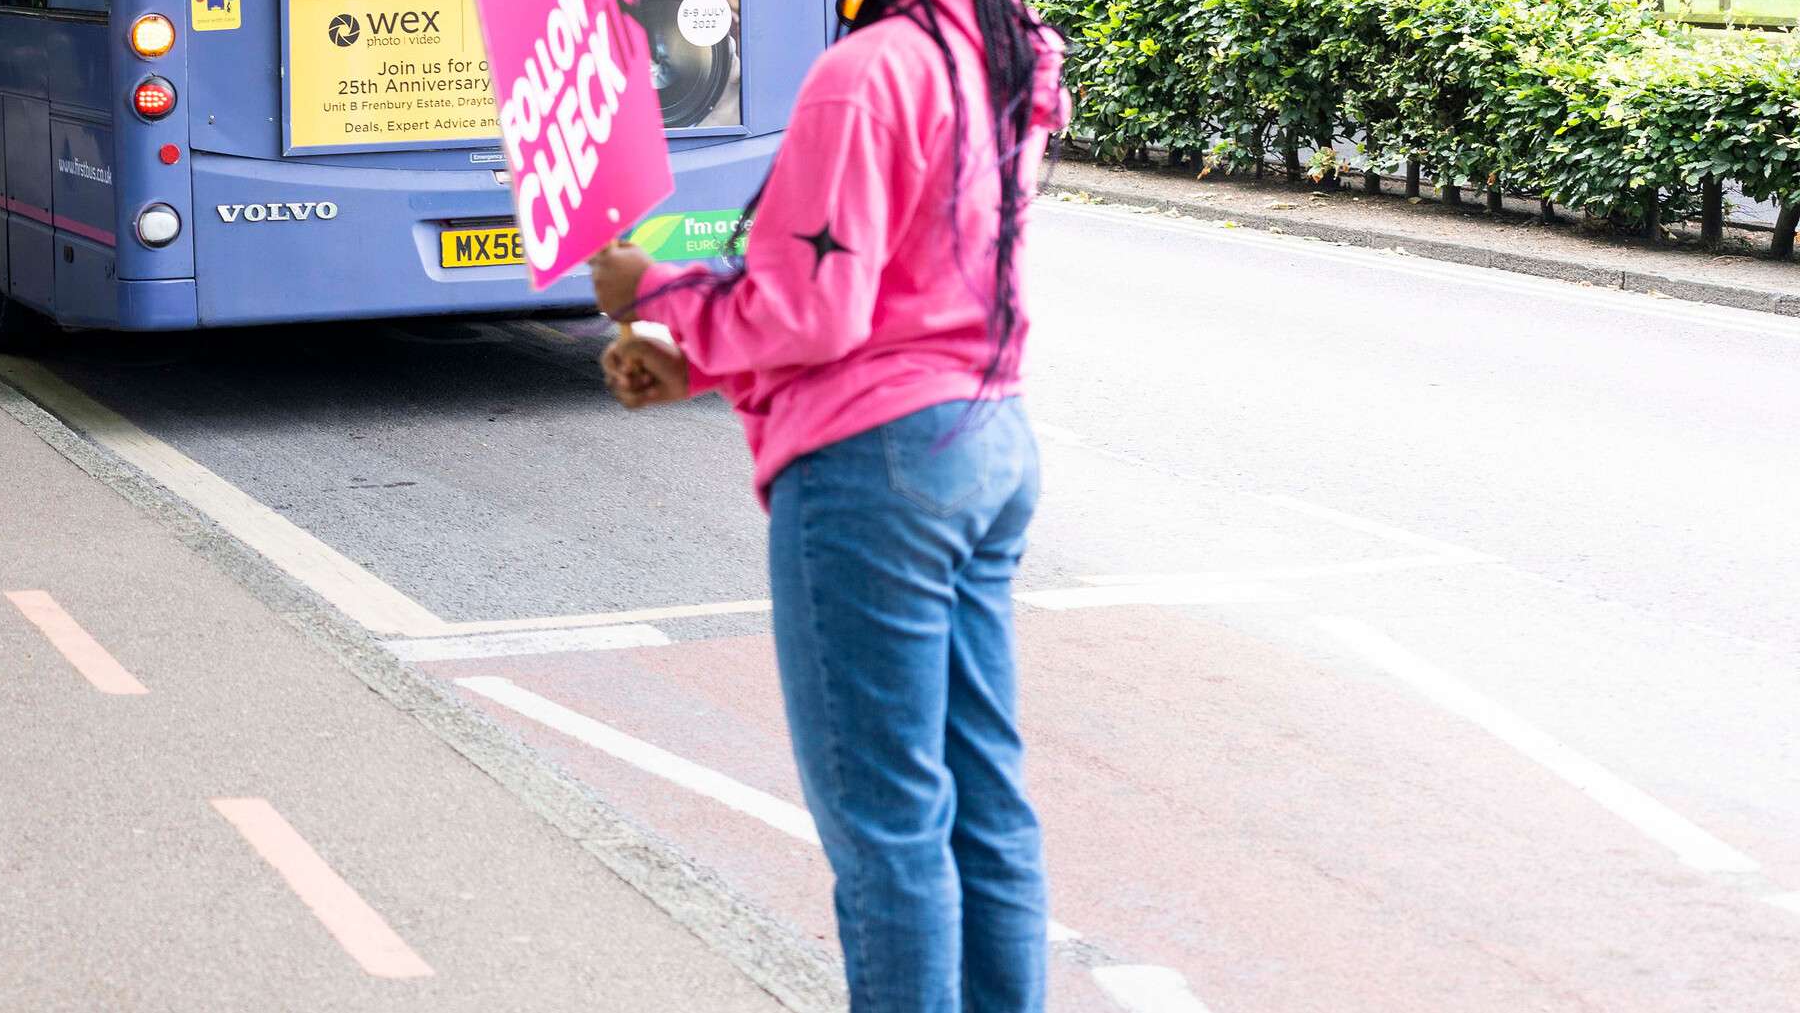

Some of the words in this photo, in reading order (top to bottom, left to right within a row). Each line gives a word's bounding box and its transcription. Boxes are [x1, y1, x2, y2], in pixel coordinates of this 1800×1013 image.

[702, 7, 726, 17] JULY
[366, 10, 440, 35] wex
[692, 19, 717, 29] 2022
[367, 35, 401, 48] photo
[408, 34, 441, 46] video
[378, 60, 416, 76] Join
[422, 62, 441, 74] us
[447, 58, 472, 73] for
[338, 79, 378, 95] 25th
[385, 76, 491, 93] Anniversary
[323, 100, 346, 112] Unit
[350, 101, 358, 111] B
[362, 98, 413, 111] Frenbury
[416, 97, 454, 109] Estate,
[457, 96, 495, 107] Drayto
[345, 120, 383, 134] Deals,
[387, 119, 429, 133] Expert
[434, 117, 476, 130] Advice
[518, 10, 628, 271] CHECK
[216, 201, 338, 223] VOLVO
[714, 219, 728, 235] a
